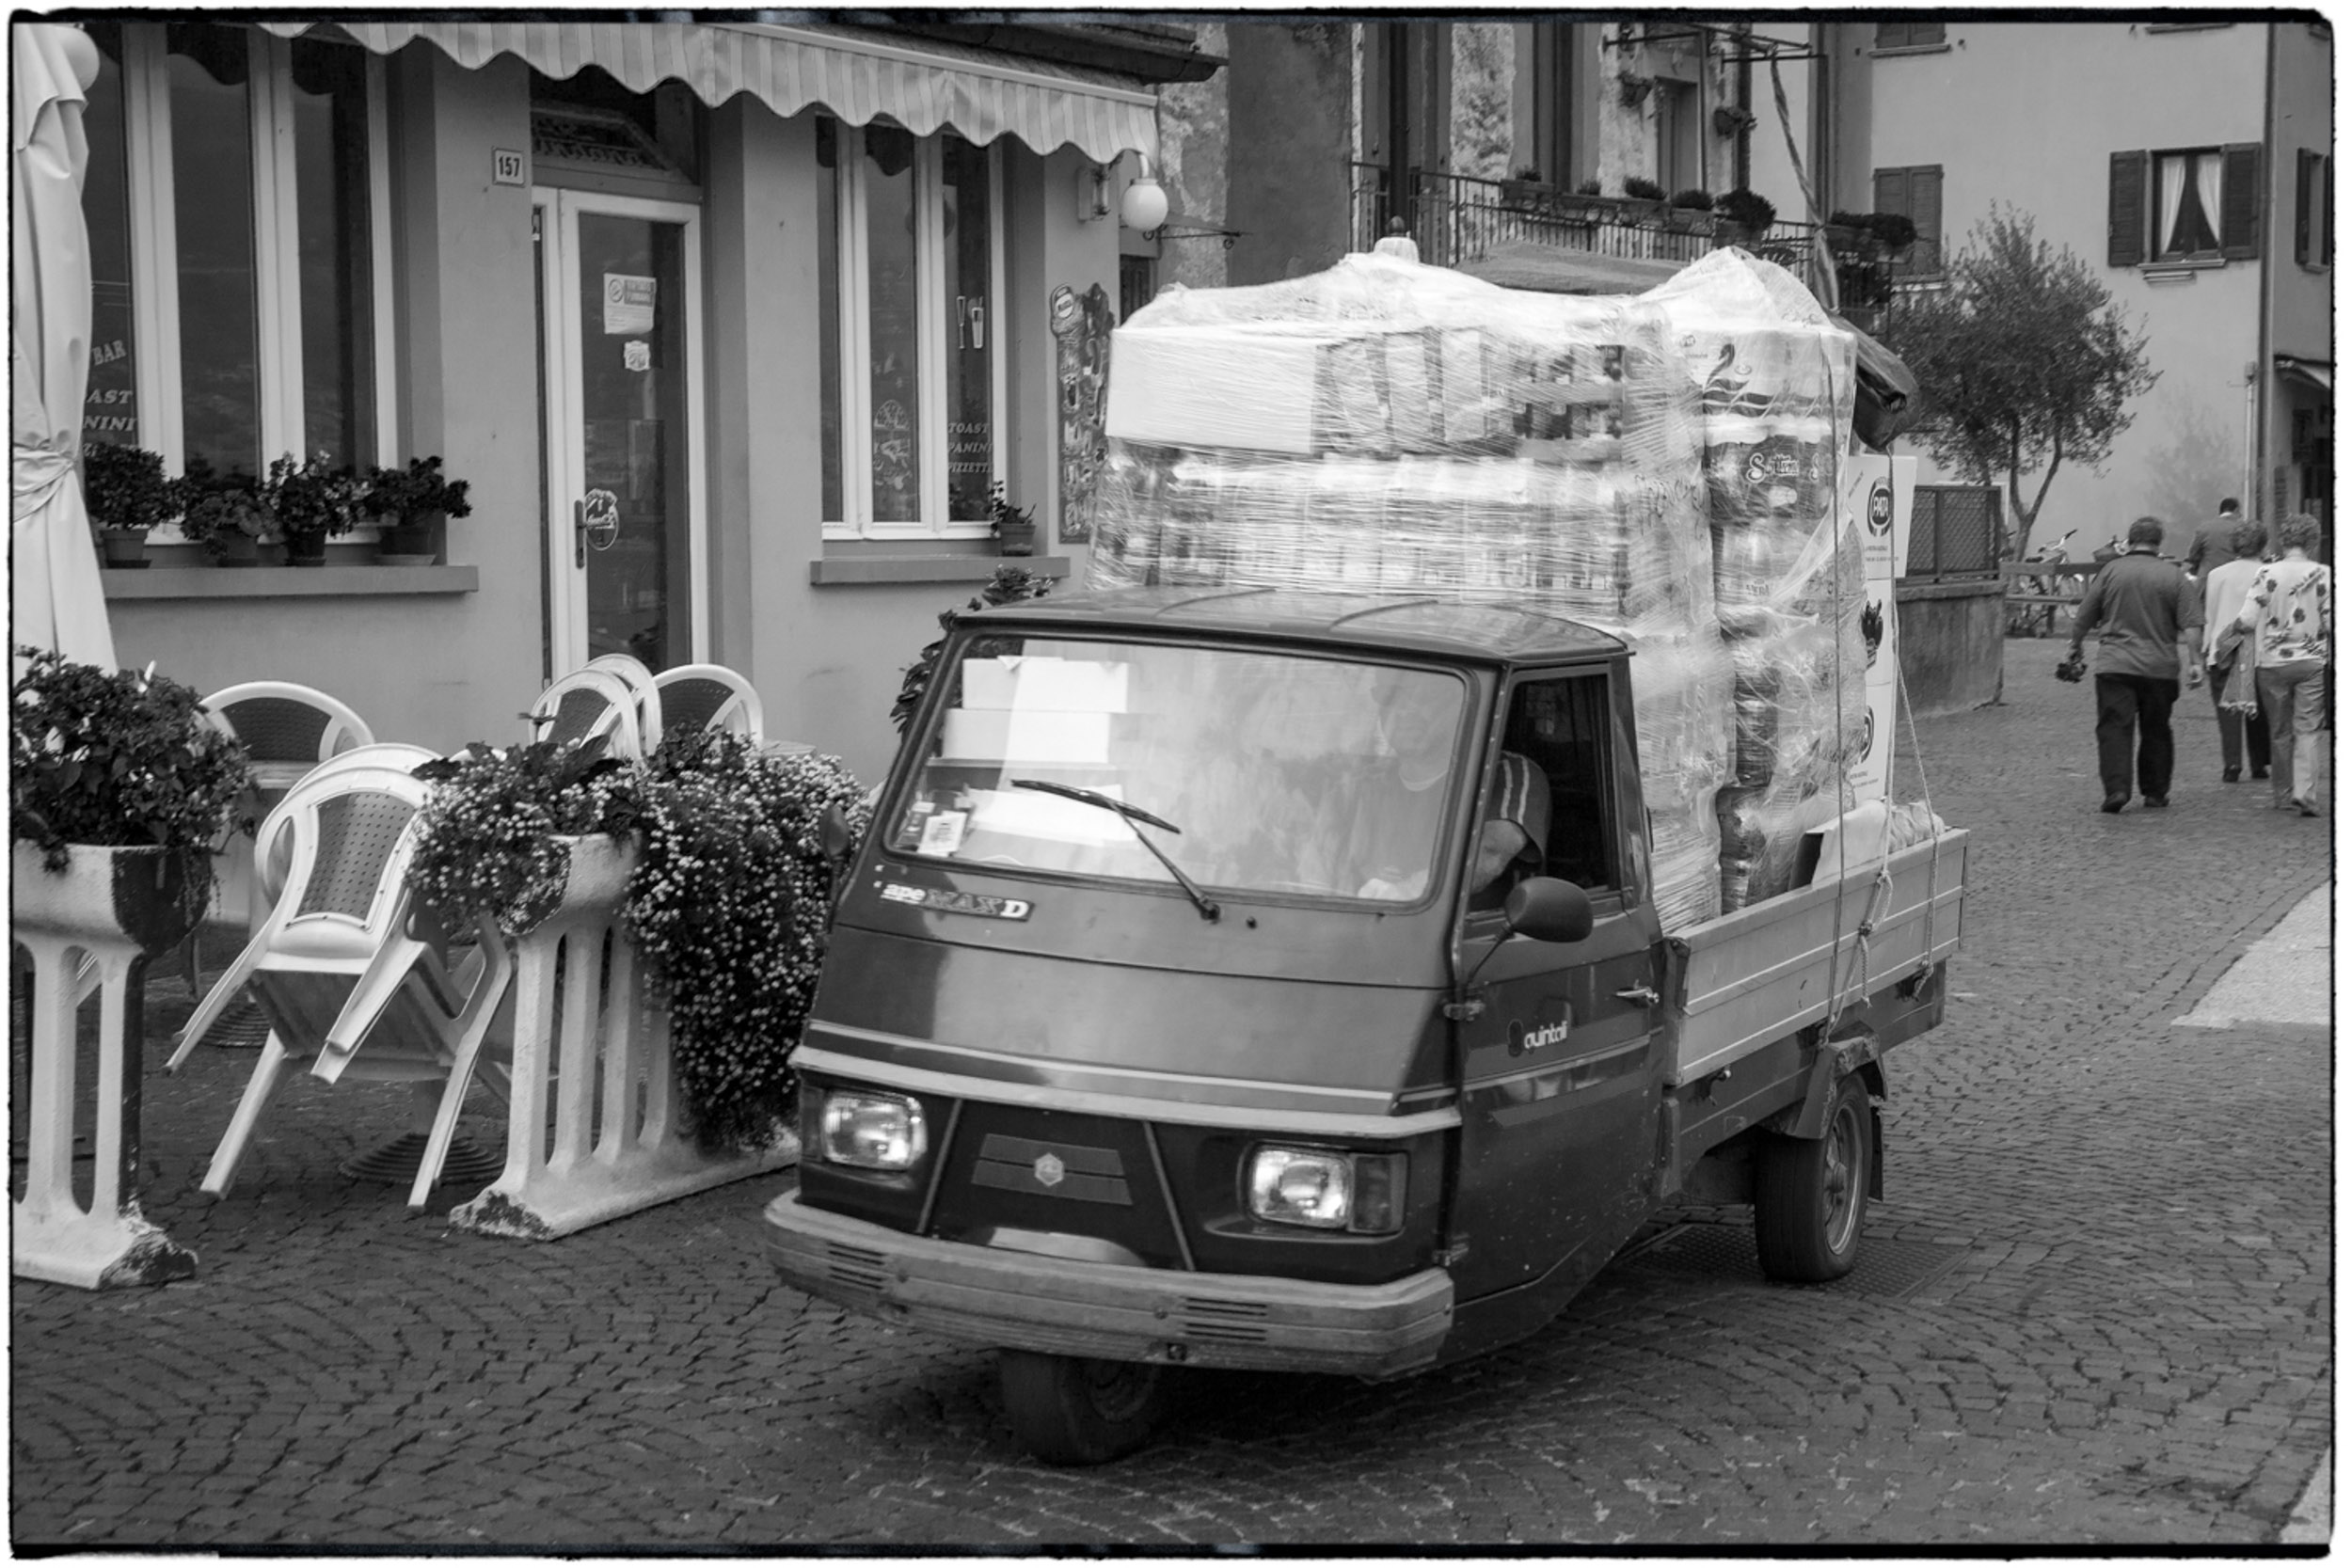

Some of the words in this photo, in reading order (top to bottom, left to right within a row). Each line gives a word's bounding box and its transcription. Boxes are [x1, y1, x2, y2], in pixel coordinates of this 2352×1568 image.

[499, 156, 520, 177] 157
[91, 340, 127, 366] BAR
[948, 421, 990, 434] TOAST
